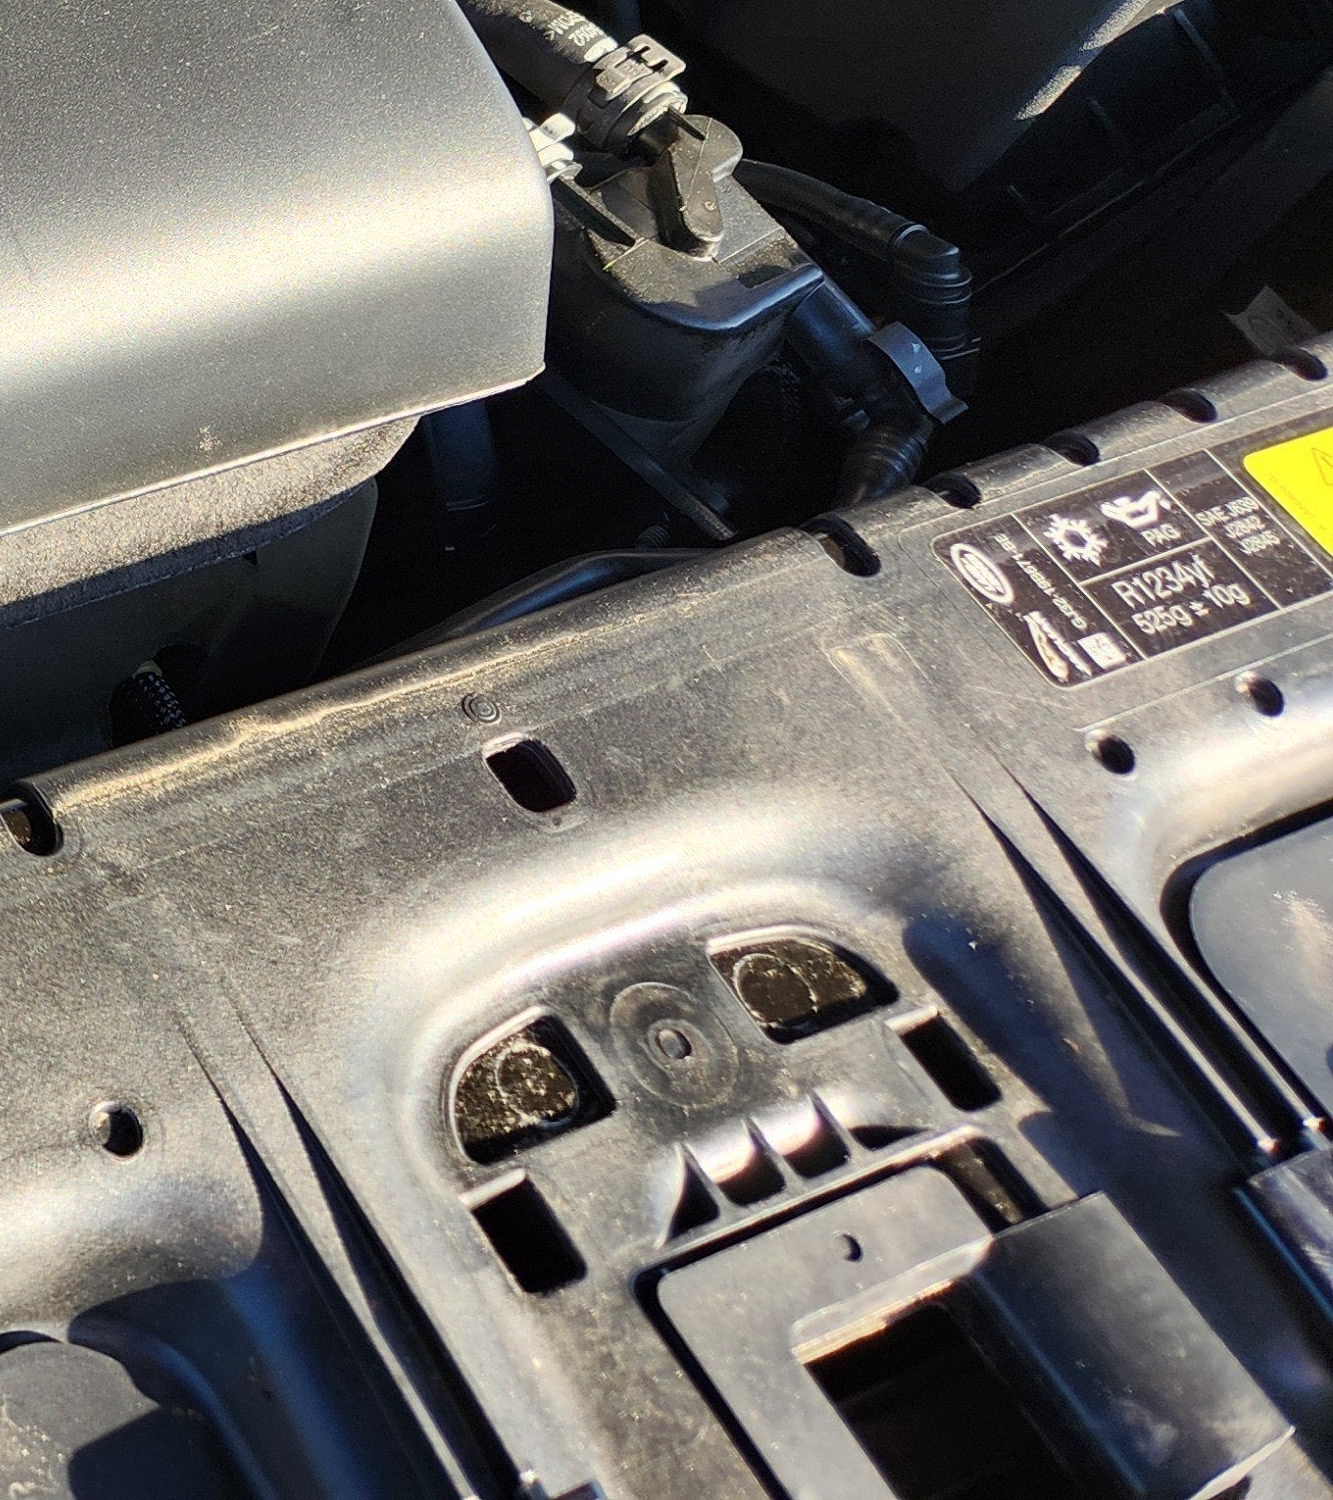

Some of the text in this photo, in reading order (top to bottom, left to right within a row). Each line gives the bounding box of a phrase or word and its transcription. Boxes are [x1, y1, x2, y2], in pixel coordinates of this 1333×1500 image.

[1194, 505, 1231, 528] SAE
[1222, 514, 1266, 539] J2842
[1140, 522, 1181, 548] PAG
[1236, 530, 1281, 555] J2845
[1111, 551, 1216, 608] R1234yf
[1131, 603, 1194, 636] 525g
[1203, 581, 1252, 608] 10g
